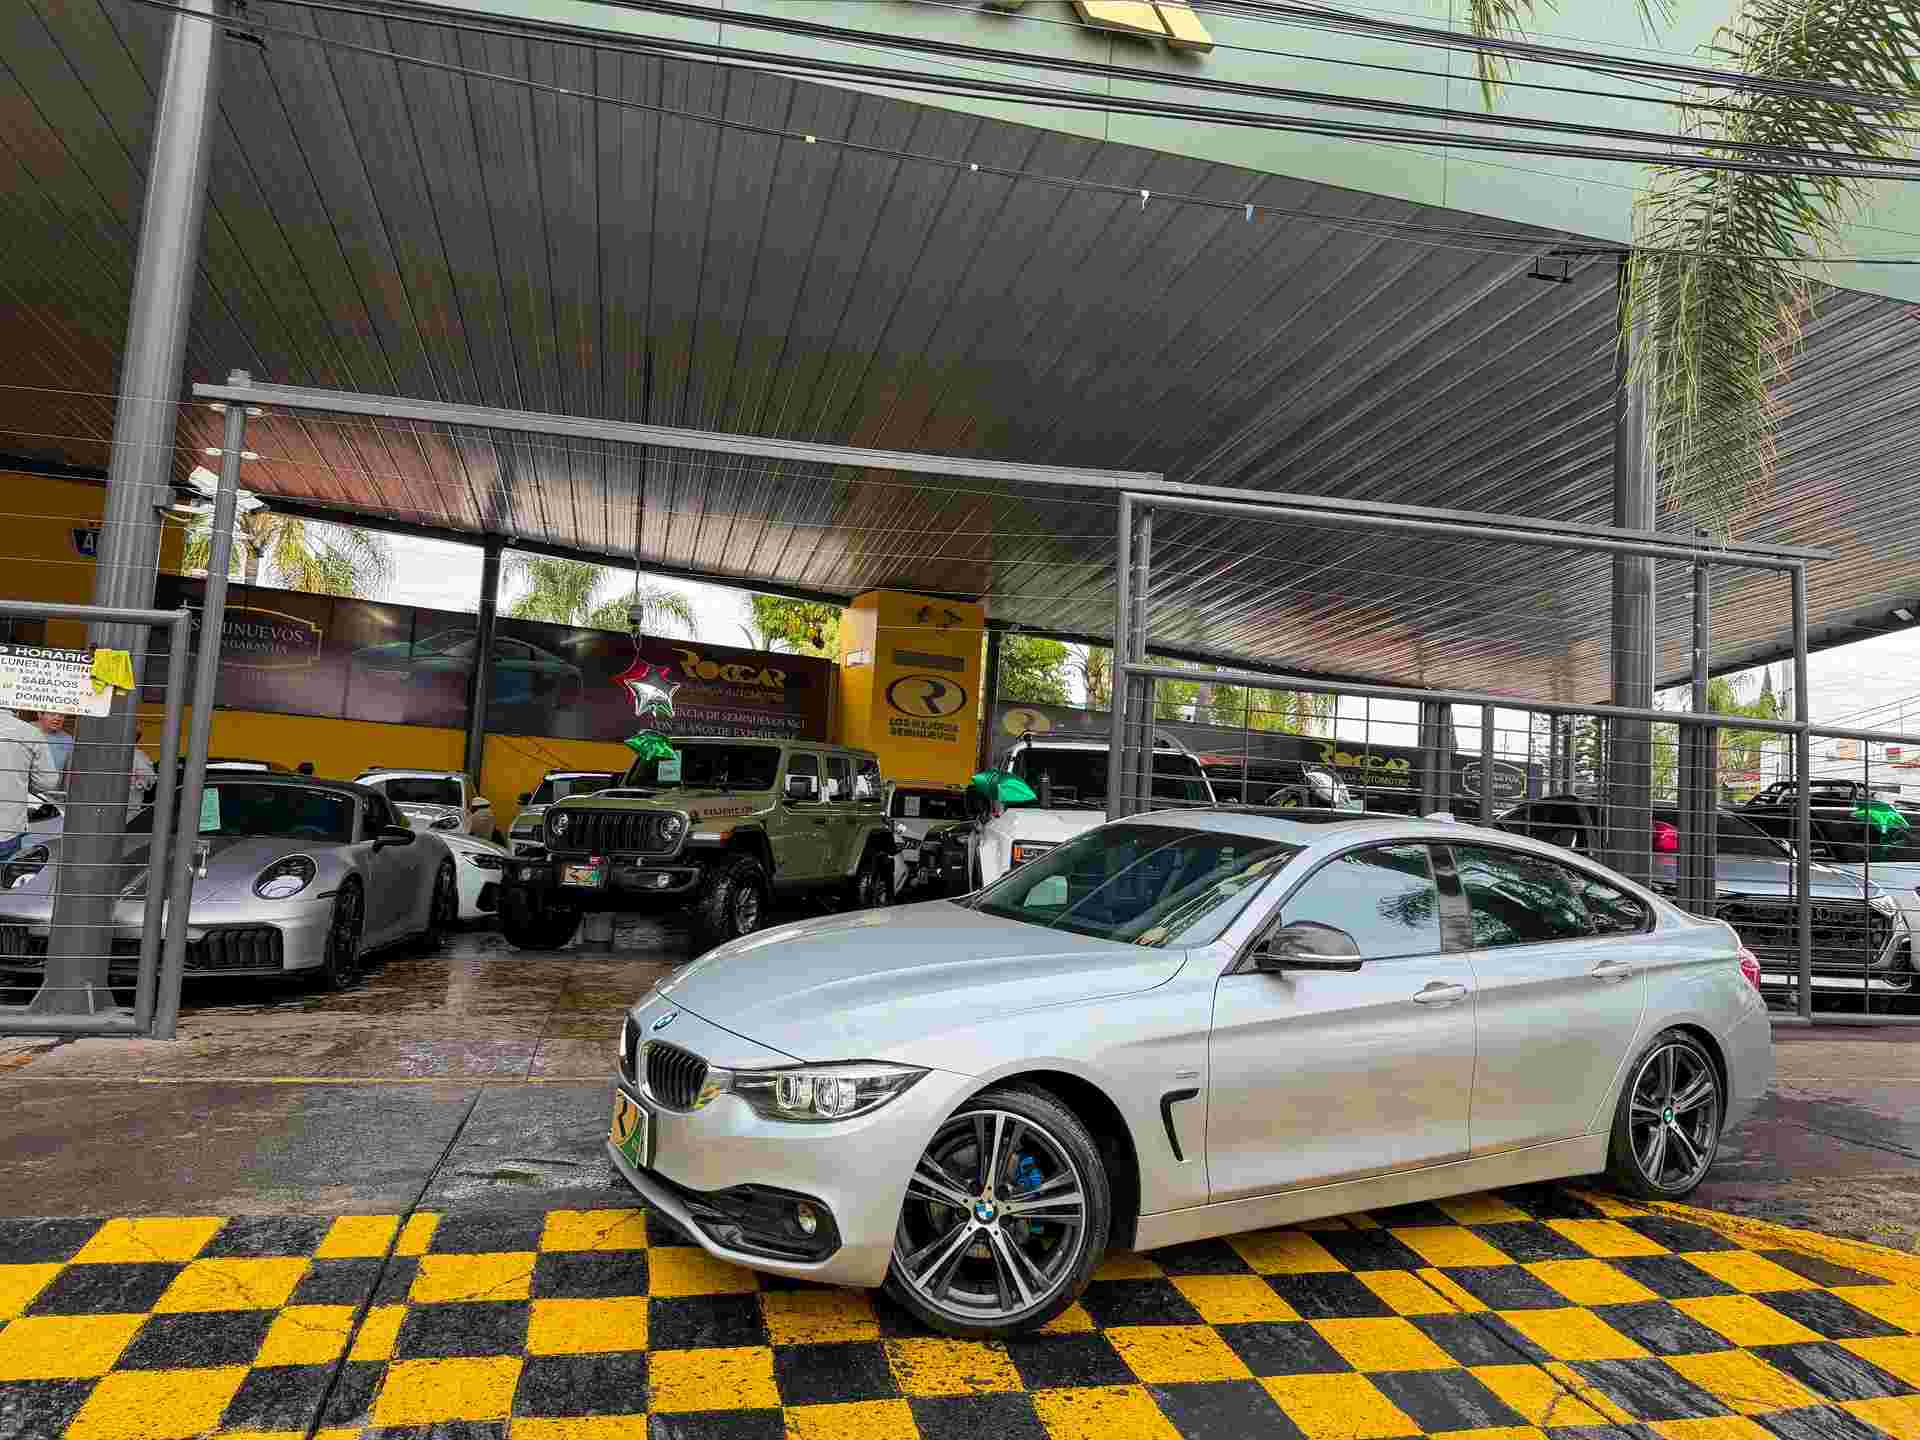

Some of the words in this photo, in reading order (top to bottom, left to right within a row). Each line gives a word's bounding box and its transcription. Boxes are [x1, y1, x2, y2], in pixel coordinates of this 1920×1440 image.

[1, 657, 39, 668] LUNES
[55, 662, 90, 674] VIERN
[15, 692, 80, 705] DOMINGOS
